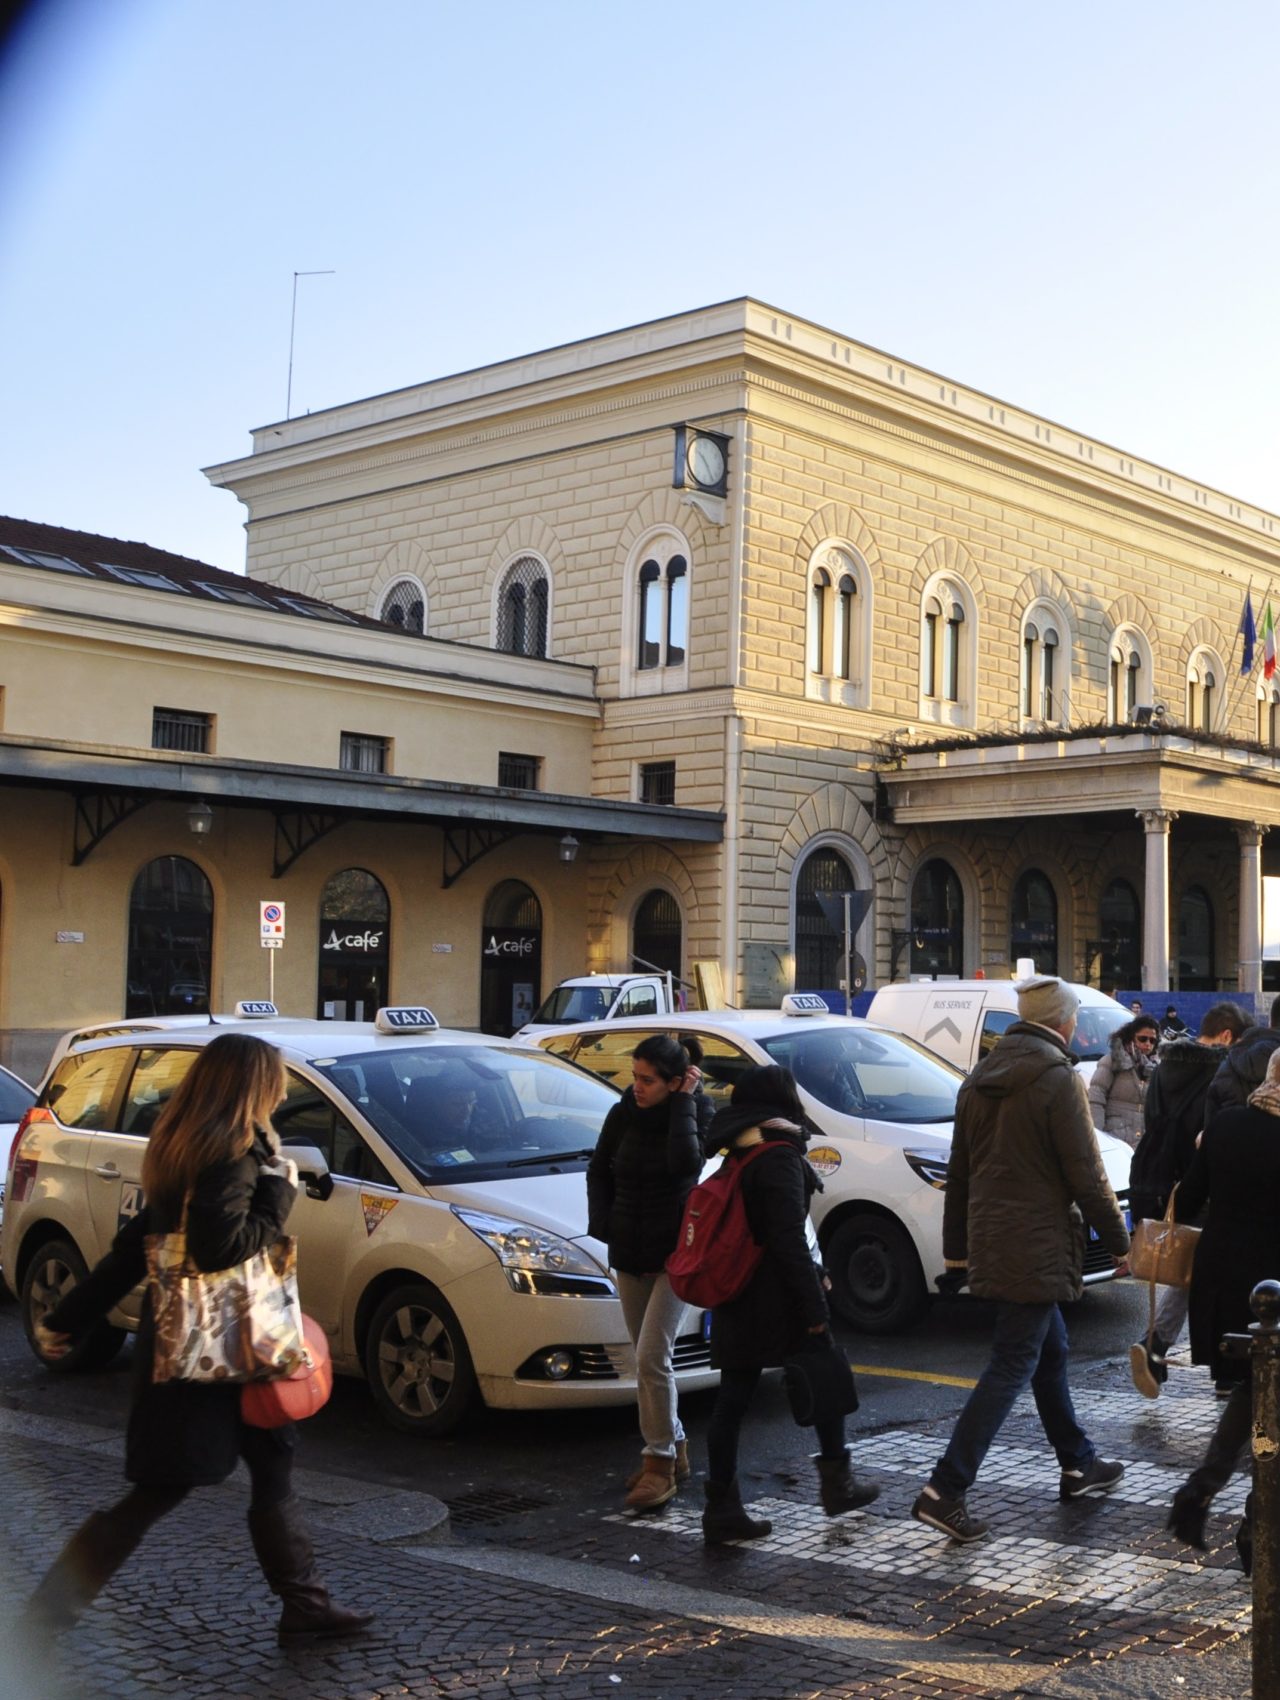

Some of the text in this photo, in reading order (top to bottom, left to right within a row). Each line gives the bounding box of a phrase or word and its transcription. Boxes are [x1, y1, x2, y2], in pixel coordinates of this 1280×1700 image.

[345, 930, 384, 952] café
[503, 937, 537, 957] café
[243, 1003, 274, 1013] TAXI
[793, 998, 825, 1008] TAXI
[933, 1000, 947, 1009] BUS
[388, 1011, 431, 1025] TAXI
